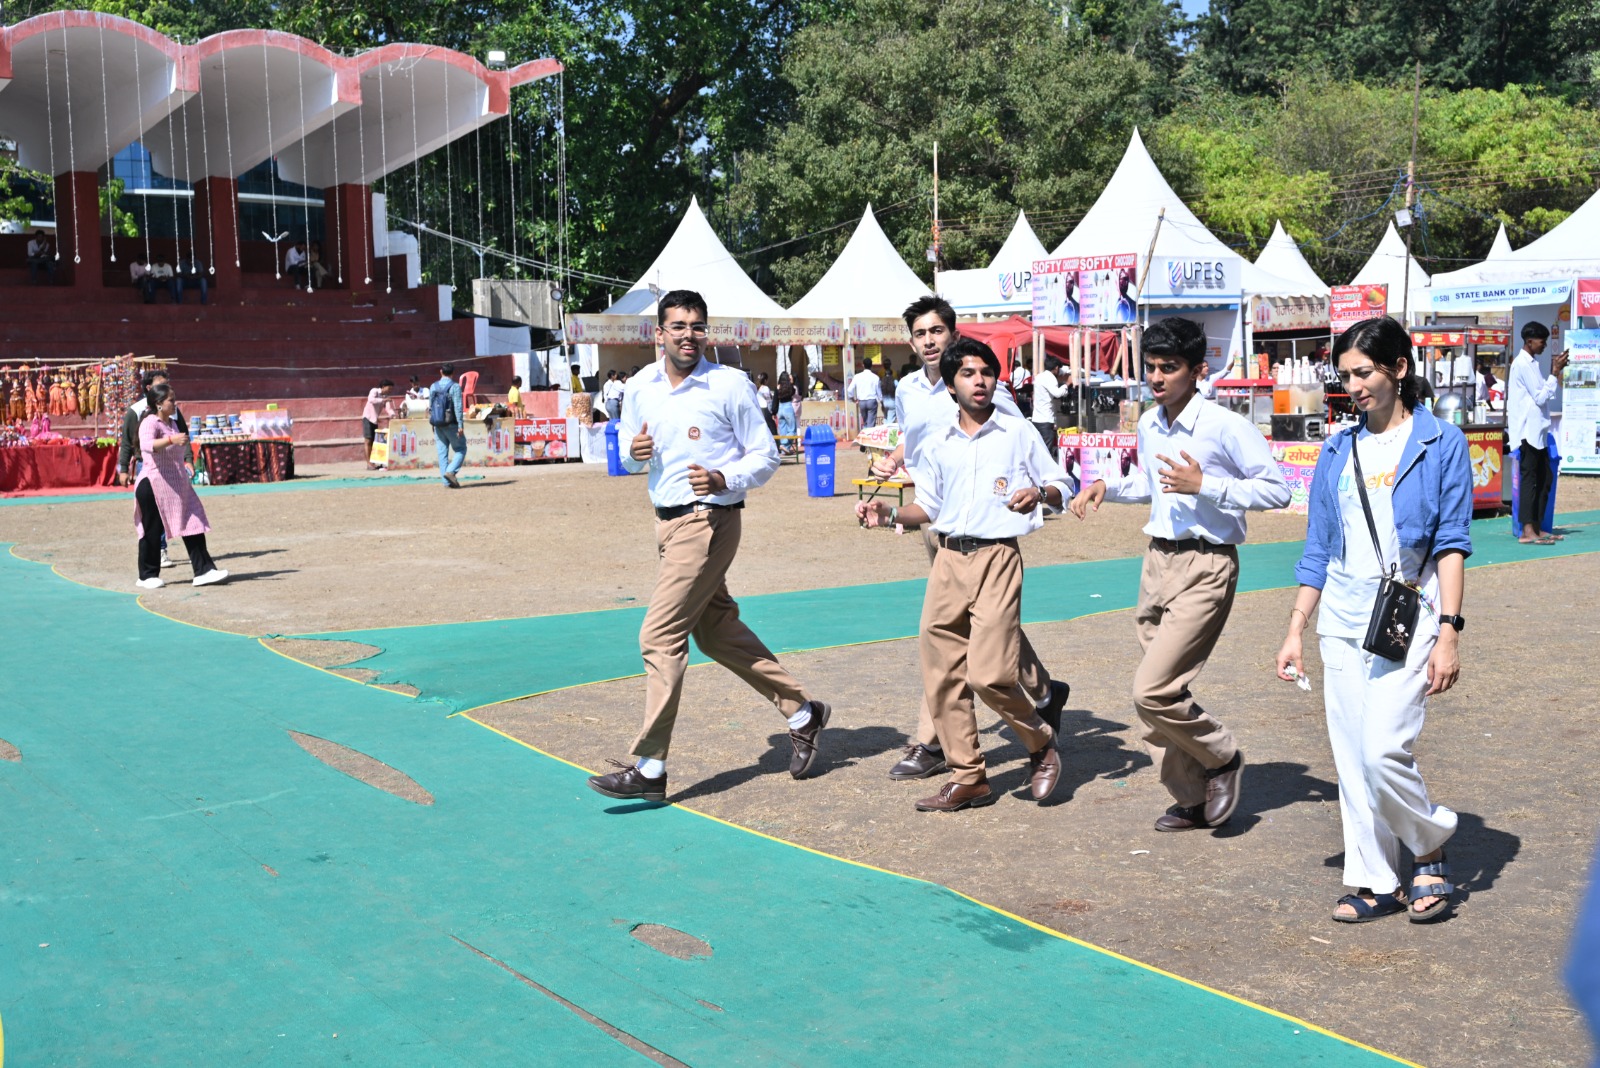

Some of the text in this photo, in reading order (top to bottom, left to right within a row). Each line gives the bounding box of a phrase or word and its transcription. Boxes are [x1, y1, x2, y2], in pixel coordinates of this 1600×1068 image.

[1032, 260, 1062, 274] SOFTY
[1080, 255, 1113, 271] SOFTY
[1183, 261, 1224, 280] UPES
[1013, 271, 1032, 289] UP
[1455, 286, 1546, 300] STATE BANK OF INDIA
[1557, 285, 1569, 294] SBI
[773, 324, 791, 336] दिल्ली
[1081, 435, 1116, 447] SOFTY
[1465, 432, 1503, 441] SWEET CORN
